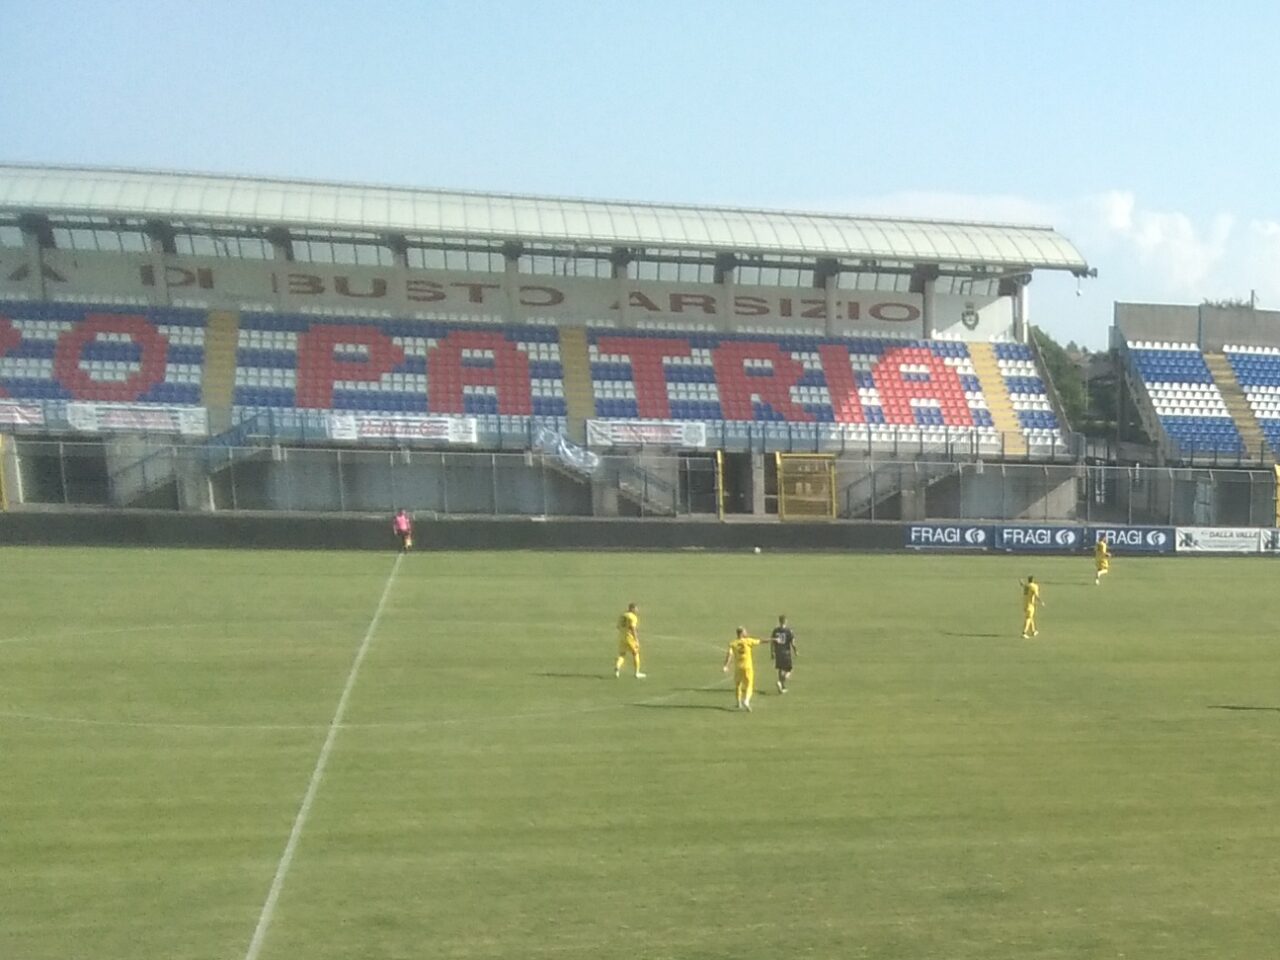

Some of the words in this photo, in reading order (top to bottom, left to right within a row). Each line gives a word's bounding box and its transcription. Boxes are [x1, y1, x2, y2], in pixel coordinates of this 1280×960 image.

[270, 272, 566, 307] BUSTO
[609, 290, 922, 323] ARSIZIO
[910, 527, 960, 543] FRAGI
[1002, 528, 1051, 545] FRAGI
[1095, 529, 1142, 545] FRAGI
